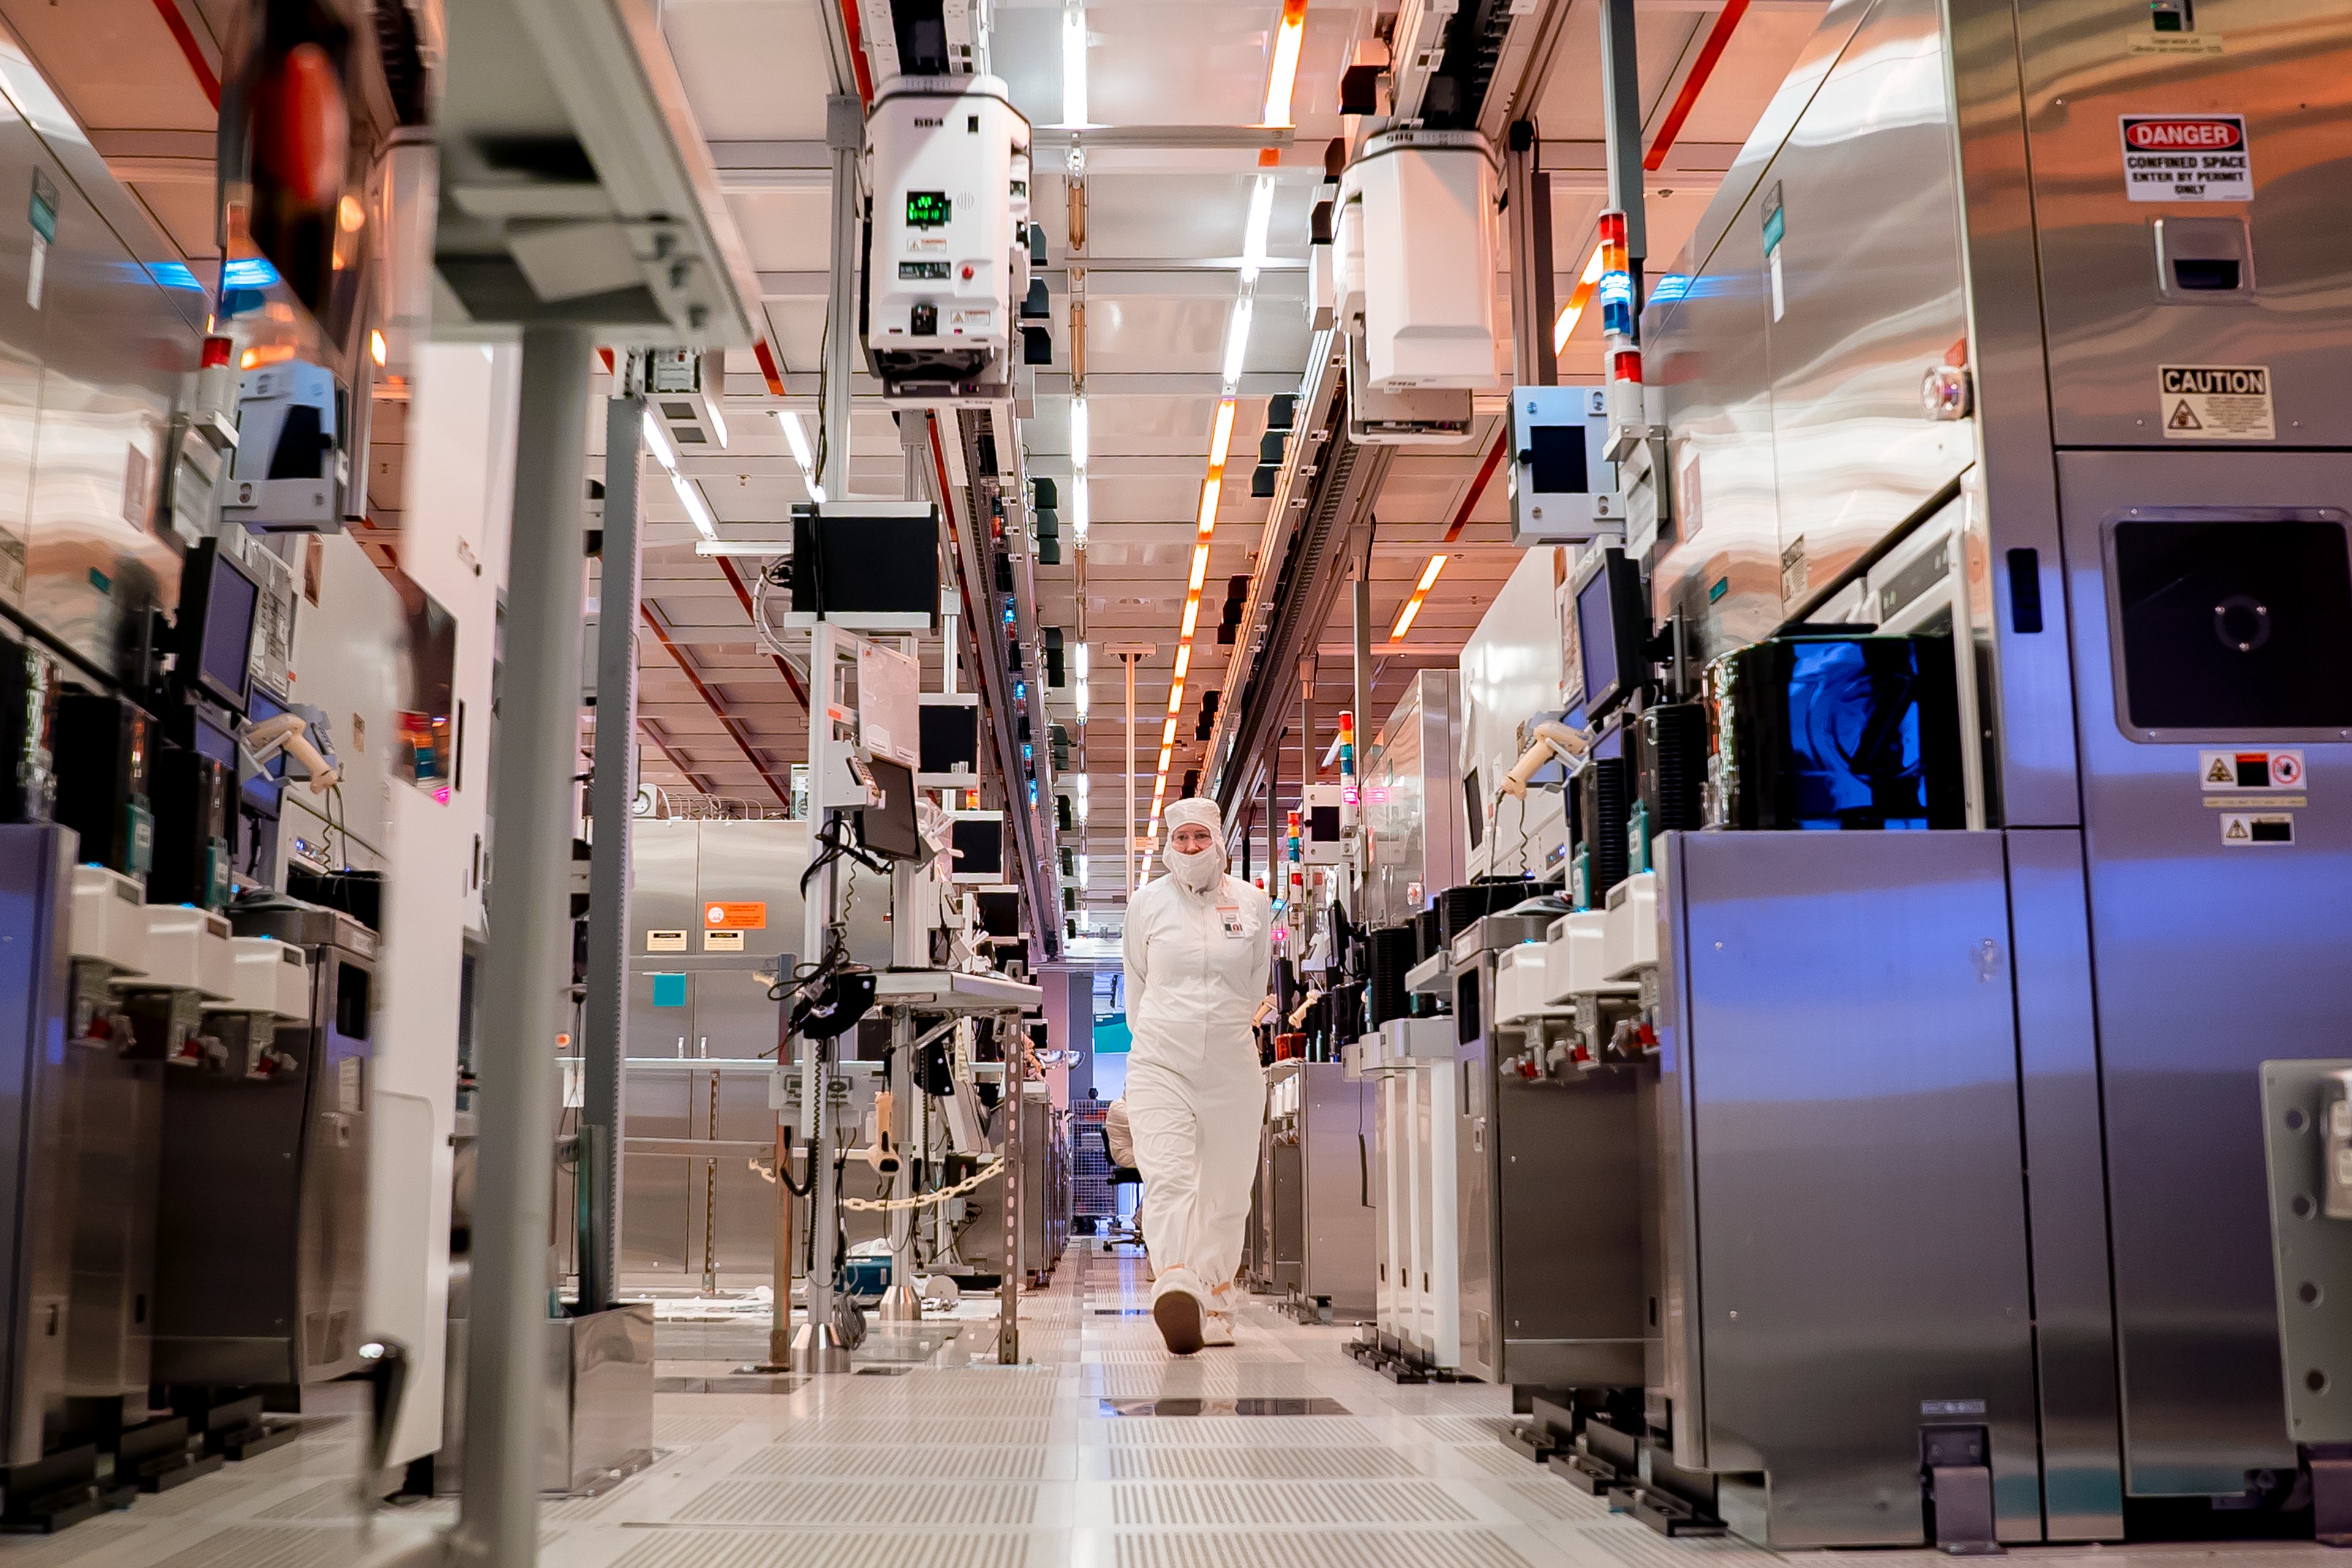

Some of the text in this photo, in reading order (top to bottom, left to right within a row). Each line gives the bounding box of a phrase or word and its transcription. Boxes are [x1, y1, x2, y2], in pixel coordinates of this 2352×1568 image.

[2136, 124, 2230, 145] DANGER
[2127, 156, 2246, 169] CONFINED SPACE
[2132, 172, 2244, 183] ENTER BY PERMIT
[2174, 184, 2205, 195] ONLY
[2165, 371, 2264, 393] CAUTION
